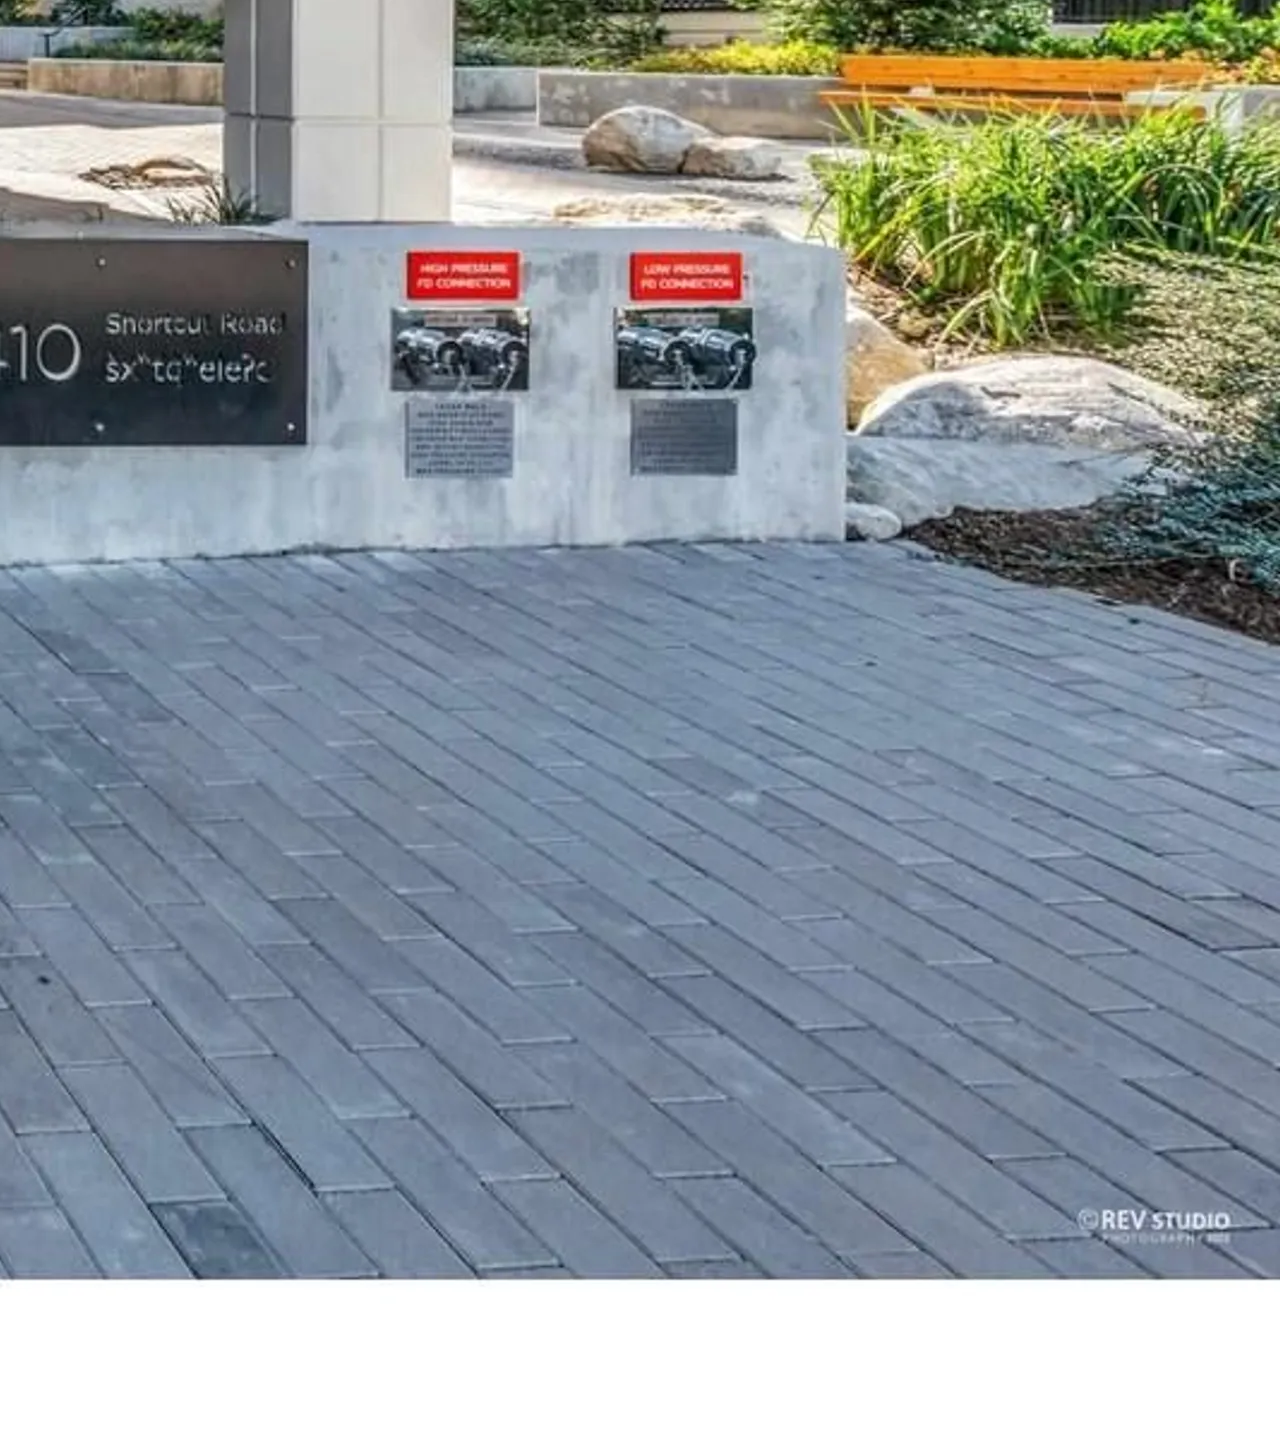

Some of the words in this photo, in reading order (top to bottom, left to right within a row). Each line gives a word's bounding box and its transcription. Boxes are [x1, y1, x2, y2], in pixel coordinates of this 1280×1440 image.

[451, 263, 508, 274] PRESSURE
[642, 263, 670, 274] LOW
[672, 263, 731, 274] PRESSURE
[435, 277, 512, 289] CONNECTION
[658, 277, 735, 289] CONNECTION
